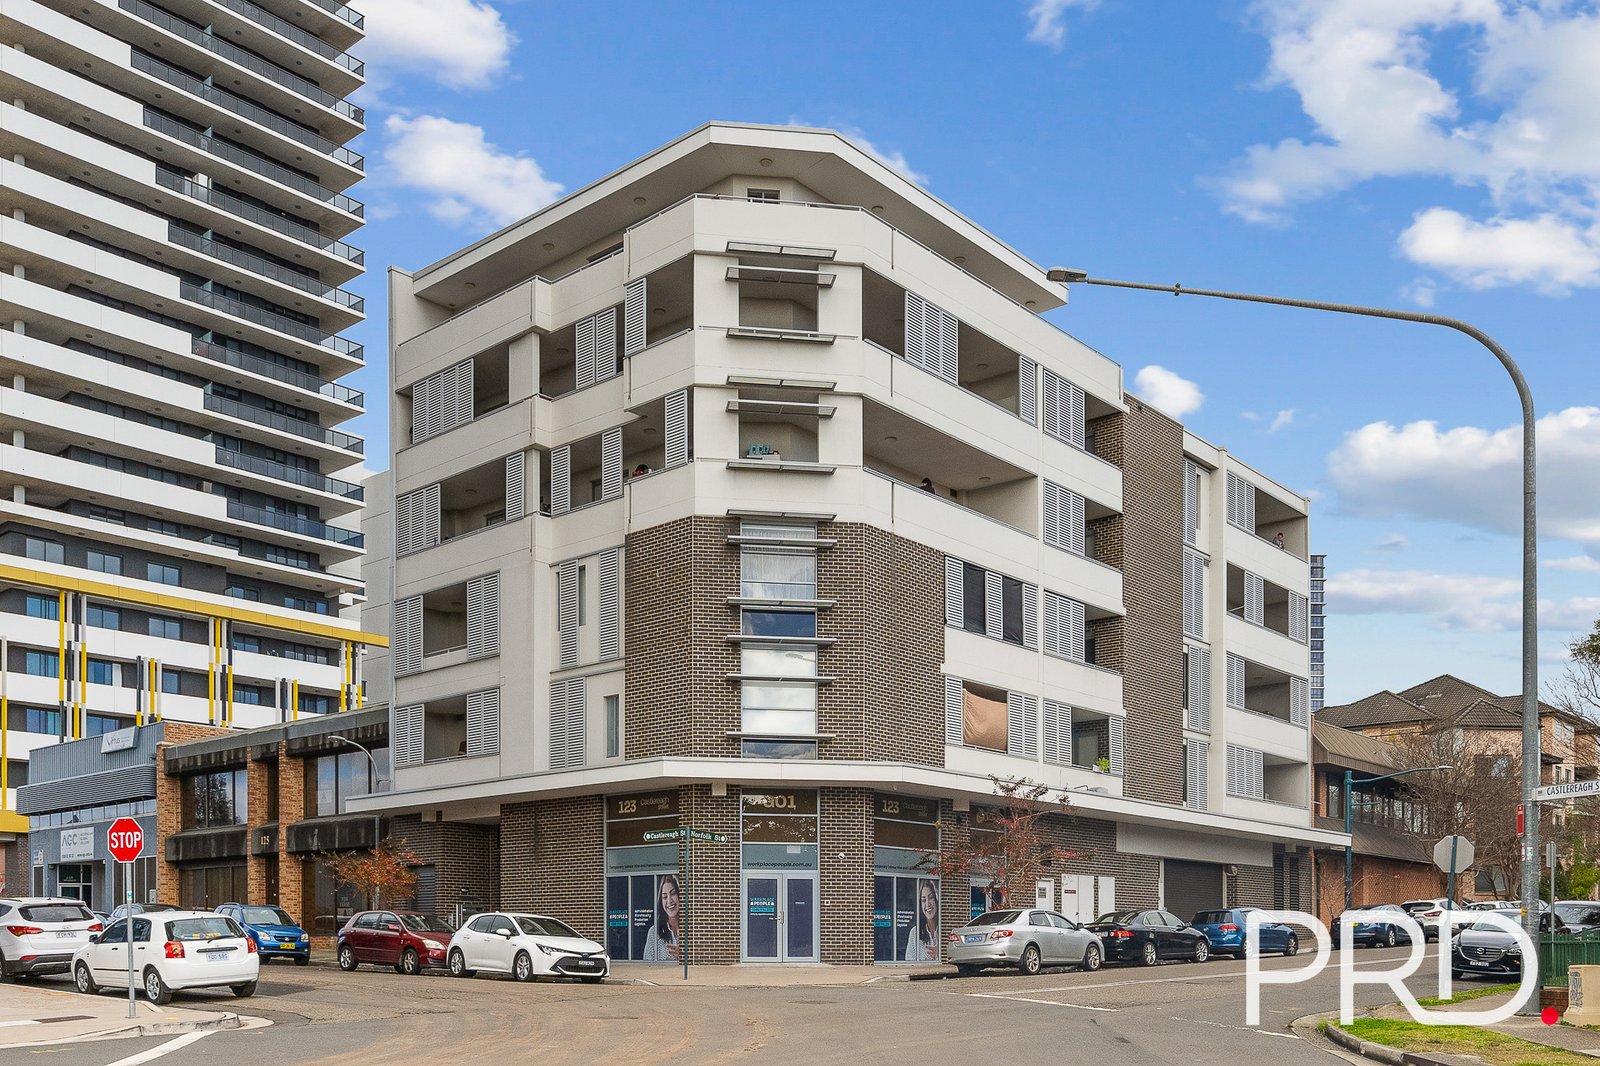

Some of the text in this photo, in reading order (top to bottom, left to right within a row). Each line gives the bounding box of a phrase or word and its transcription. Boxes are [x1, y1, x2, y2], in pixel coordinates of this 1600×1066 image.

[1546, 782, 1593, 796] CASTLEREAGH
[618, 800, 637, 814] 123
[882, 800, 900, 814] 123
[62, 833, 78, 847] AGC
[111, 832, 142, 849] STOP
[650, 829, 686, 840] Castlereagh St
[690, 831, 712, 840] Norfolk
